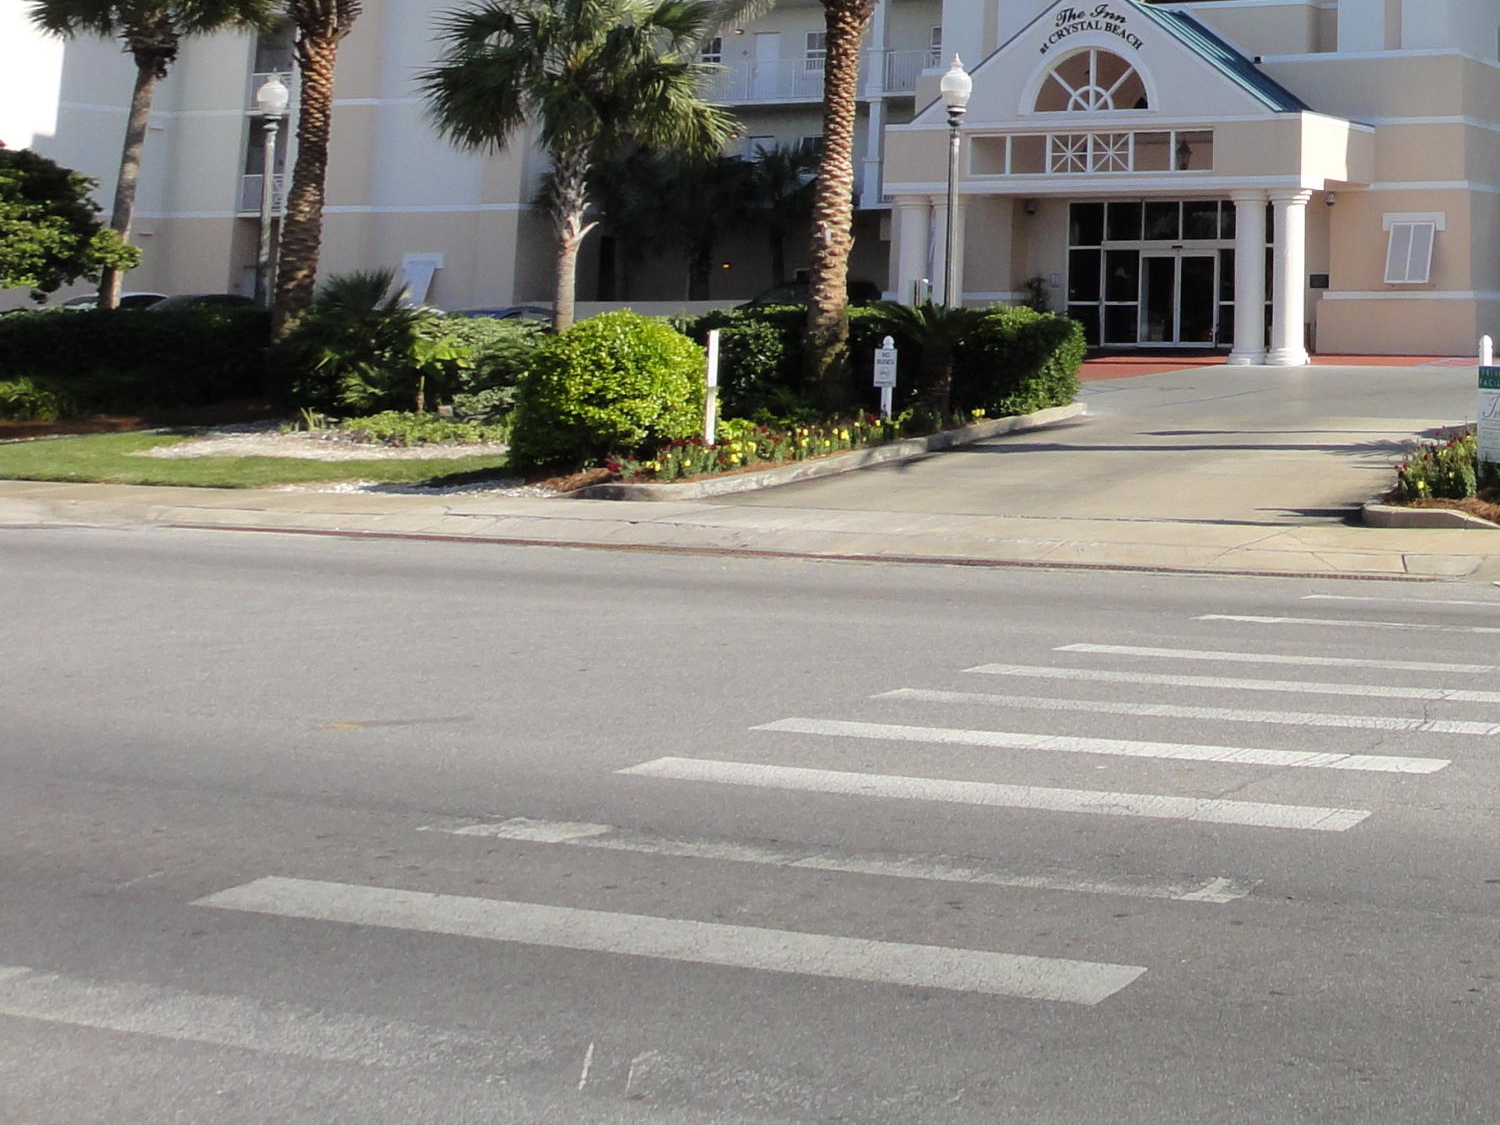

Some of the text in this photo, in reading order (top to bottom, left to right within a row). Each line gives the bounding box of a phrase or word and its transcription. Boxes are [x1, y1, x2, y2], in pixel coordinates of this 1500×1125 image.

[1055, 3, 1127, 28] The Inn
[1039, 20, 1144, 55] at CRYSTAL BEACH
